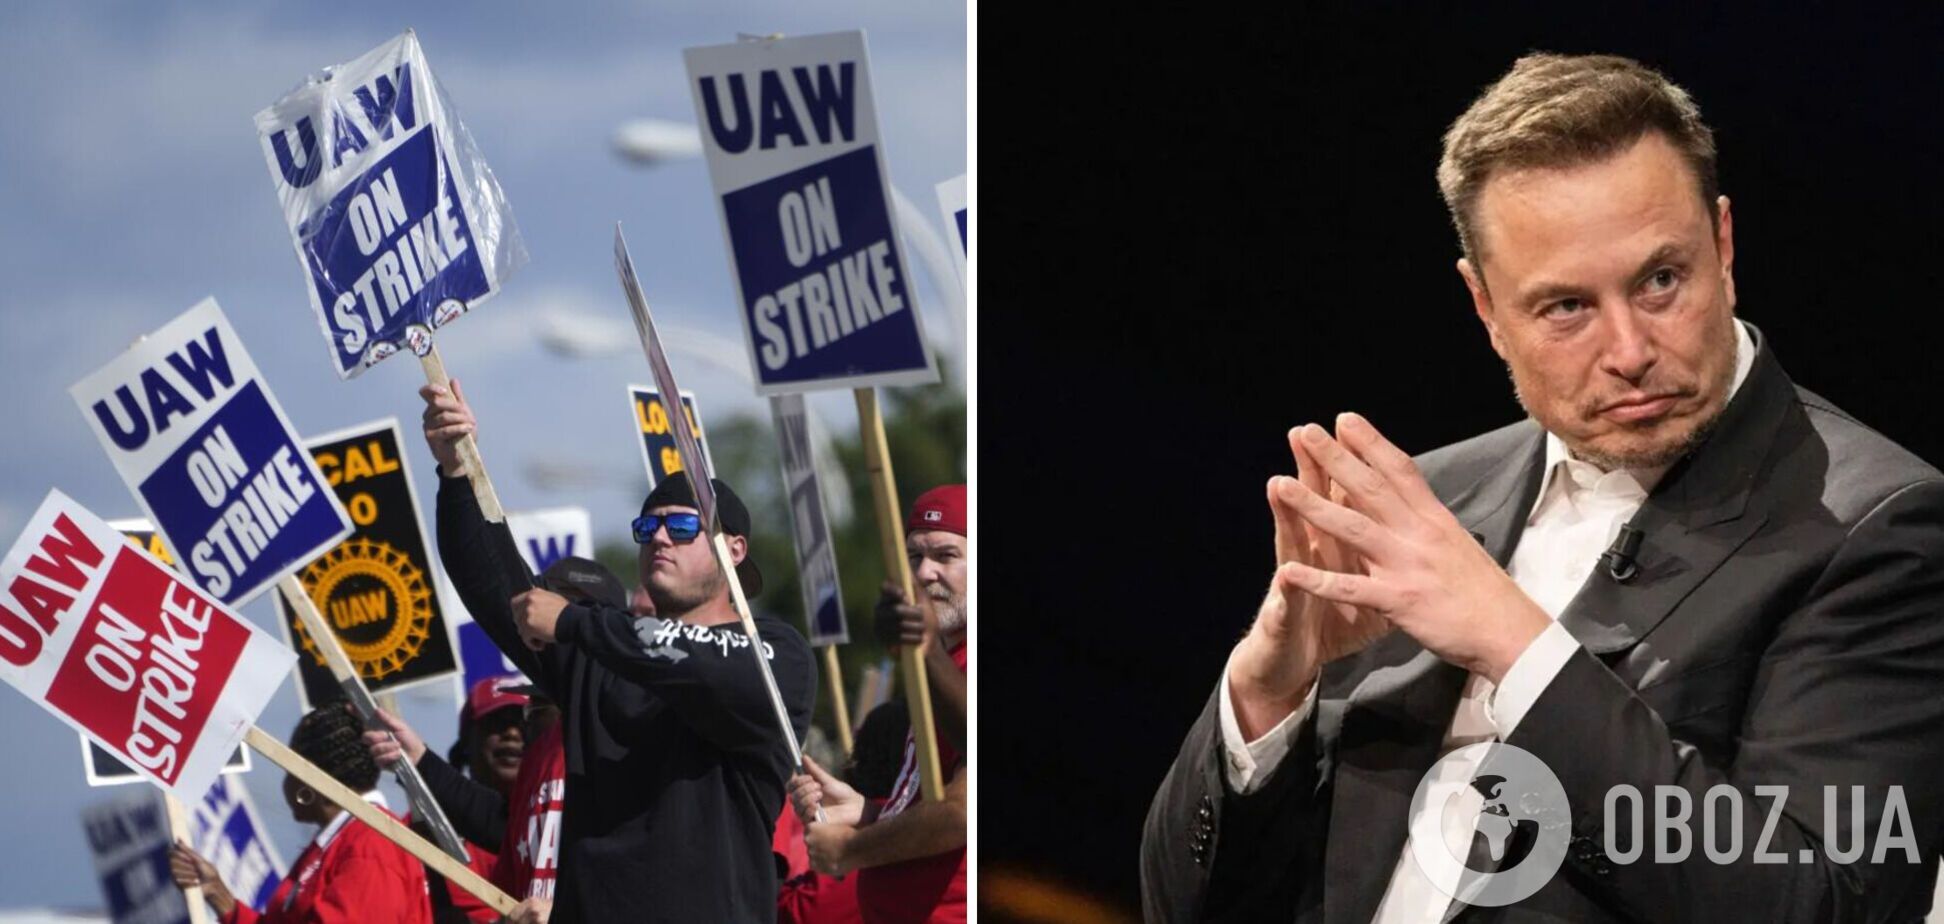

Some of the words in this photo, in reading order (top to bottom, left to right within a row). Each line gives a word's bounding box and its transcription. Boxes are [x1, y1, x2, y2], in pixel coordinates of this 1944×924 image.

[270, 62, 416, 189] UAW
[698, 61, 856, 155] UAW
[333, 196, 468, 355] STRIKE
[349, 167, 409, 257] ON
[777, 175, 843, 268] ON
[753, 239, 905, 371] STRIKE
[92, 326, 236, 453] UAW
[186, 424, 249, 509] ON
[191, 444, 316, 599] STRIKE
[0, 511, 106, 667] UAW
[84, 602, 147, 692] ON
[331, 590, 388, 630] UAW
[125, 580, 213, 780] STRIKE
